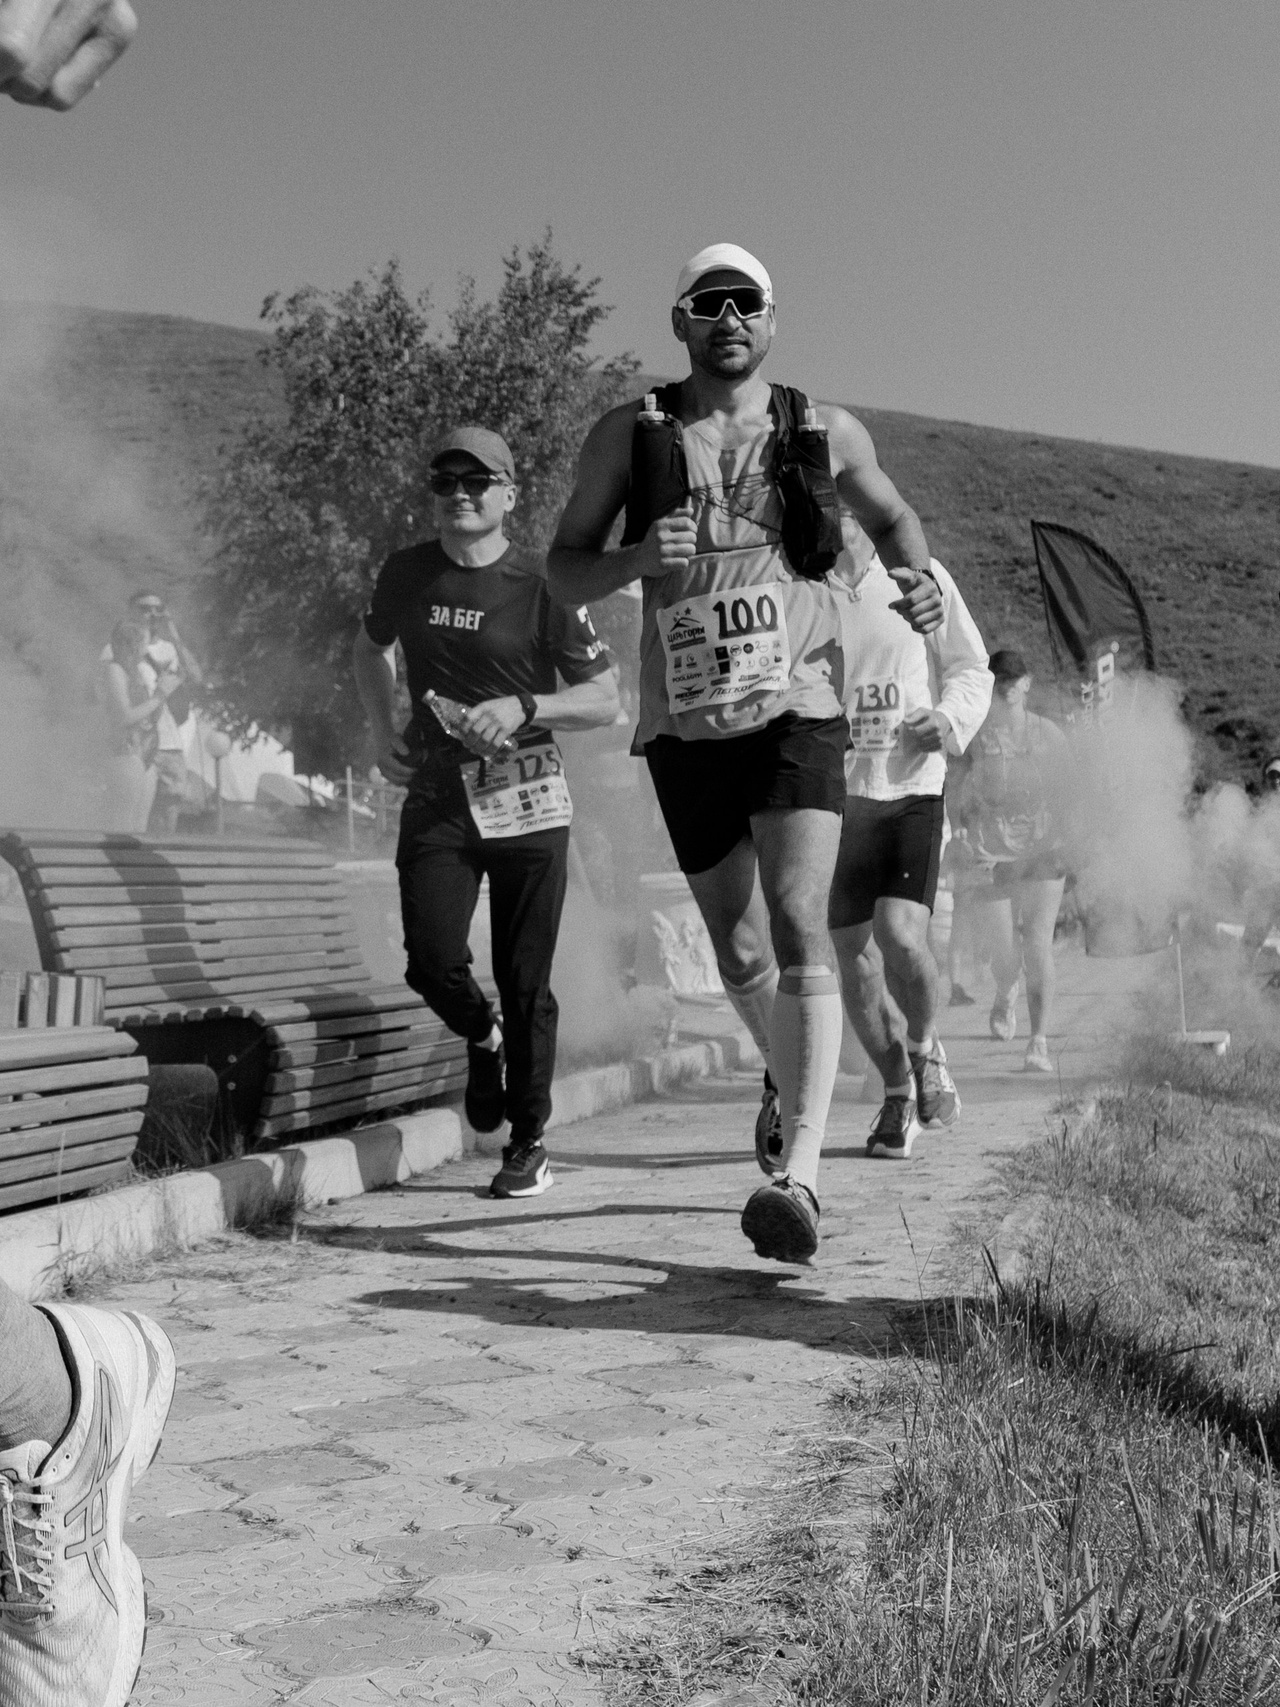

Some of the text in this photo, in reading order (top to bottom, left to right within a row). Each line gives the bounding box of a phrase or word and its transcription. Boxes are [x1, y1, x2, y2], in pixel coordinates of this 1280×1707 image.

[428, 605, 485, 631] ЗА БЕГ
[712, 594, 778, 638] 100
[854, 682, 900, 713] 130
[514, 750, 561, 784] 125
